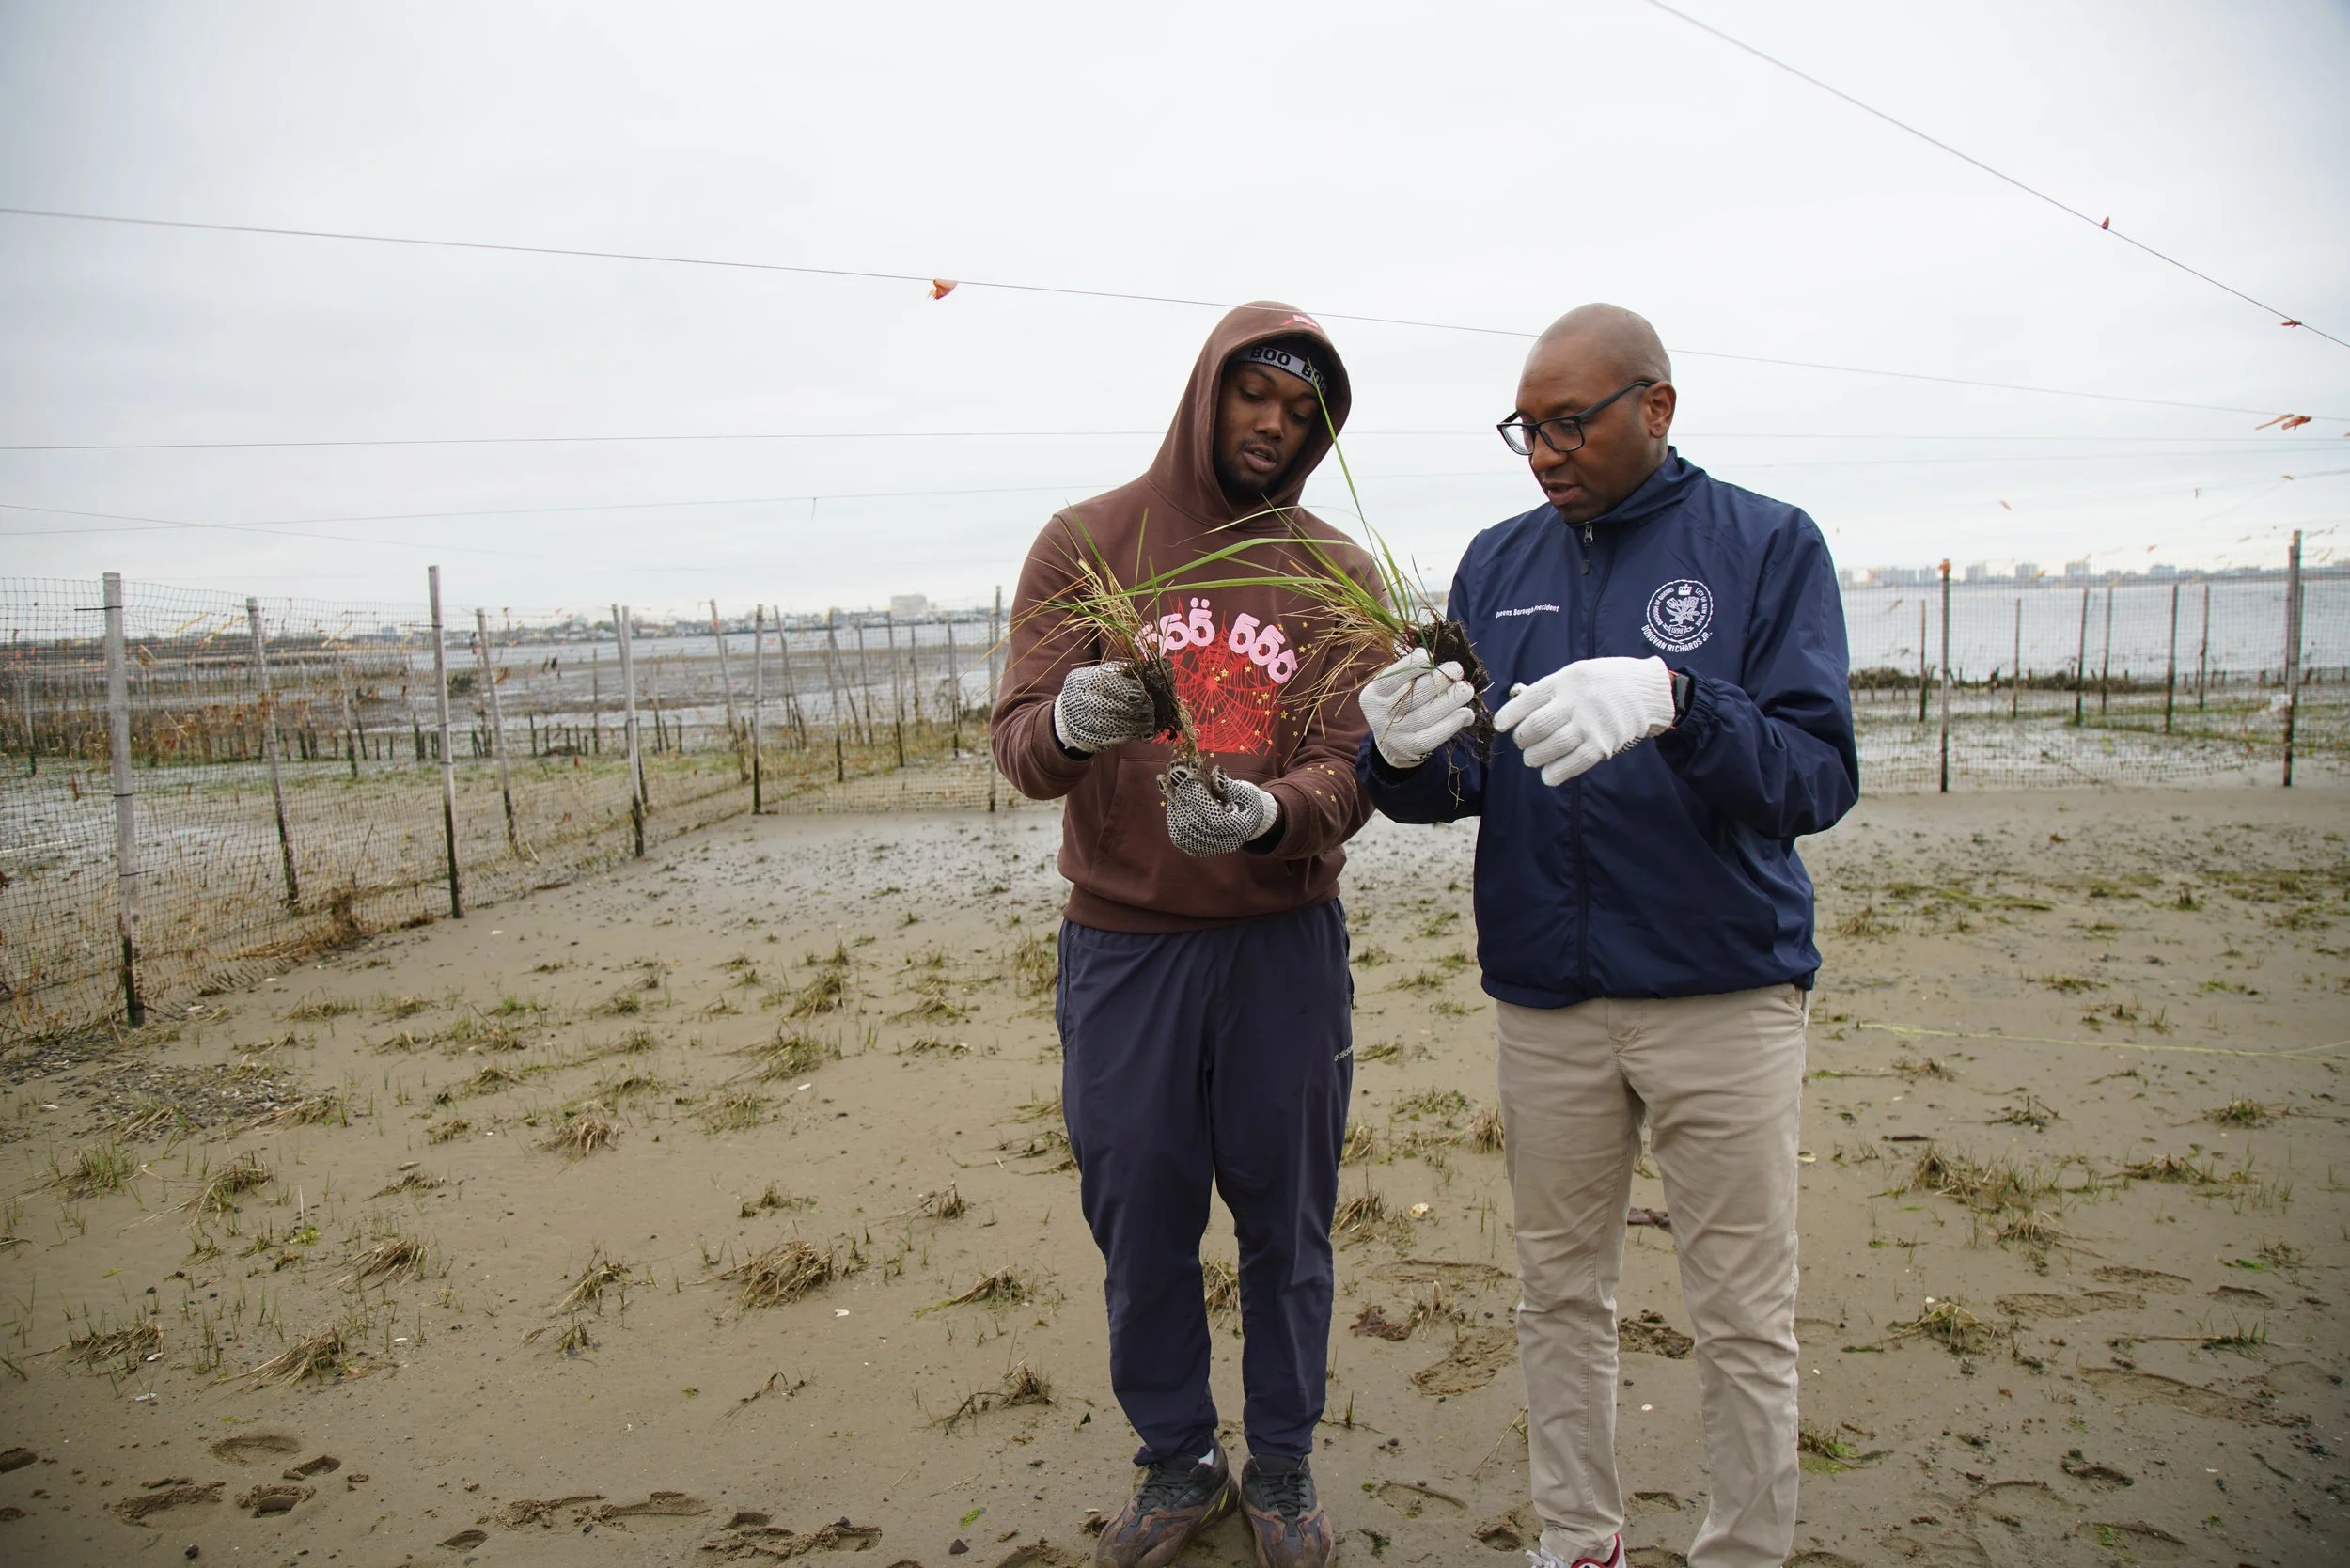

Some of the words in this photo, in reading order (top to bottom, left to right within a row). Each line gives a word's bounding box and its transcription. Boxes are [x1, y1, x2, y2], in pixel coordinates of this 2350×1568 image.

[1250, 347, 1292, 367] BOO
[1695, 588, 1704, 597] CITY
[1513, 606, 1534, 616] Borough
[1533, 603, 1559, 612] President
[1695, 614, 1706, 627] YORK
[1641, 624, 1668, 650] DONOVAN
[1667, 637, 1703, 652] RICHARDS
[1701, 631, 1713, 642] JR.
[1228, 613, 1298, 684] 555
